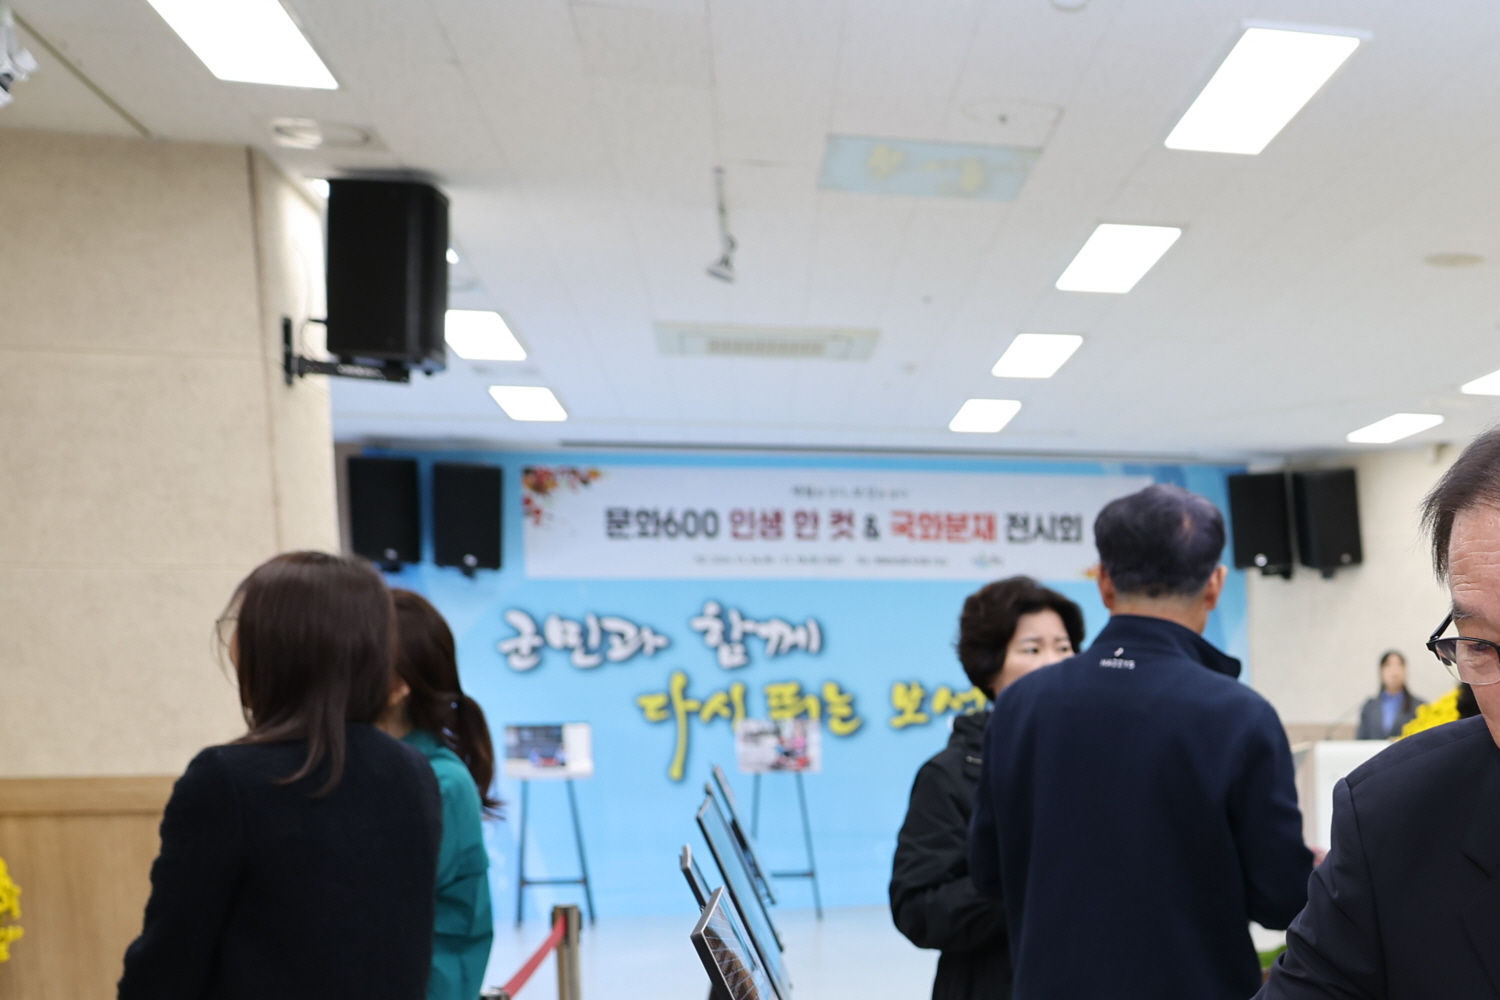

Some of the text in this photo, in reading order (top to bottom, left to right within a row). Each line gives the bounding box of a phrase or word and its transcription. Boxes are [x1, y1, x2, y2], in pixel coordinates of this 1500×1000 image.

[605, 508, 1084, 544] 문화600 인생 한 컷 & 국화분재 전시회
[498, 600, 822, 671] 군민과 함께
[636, 671, 747, 781] 다시
[764, 682, 863, 735] 뛰는
